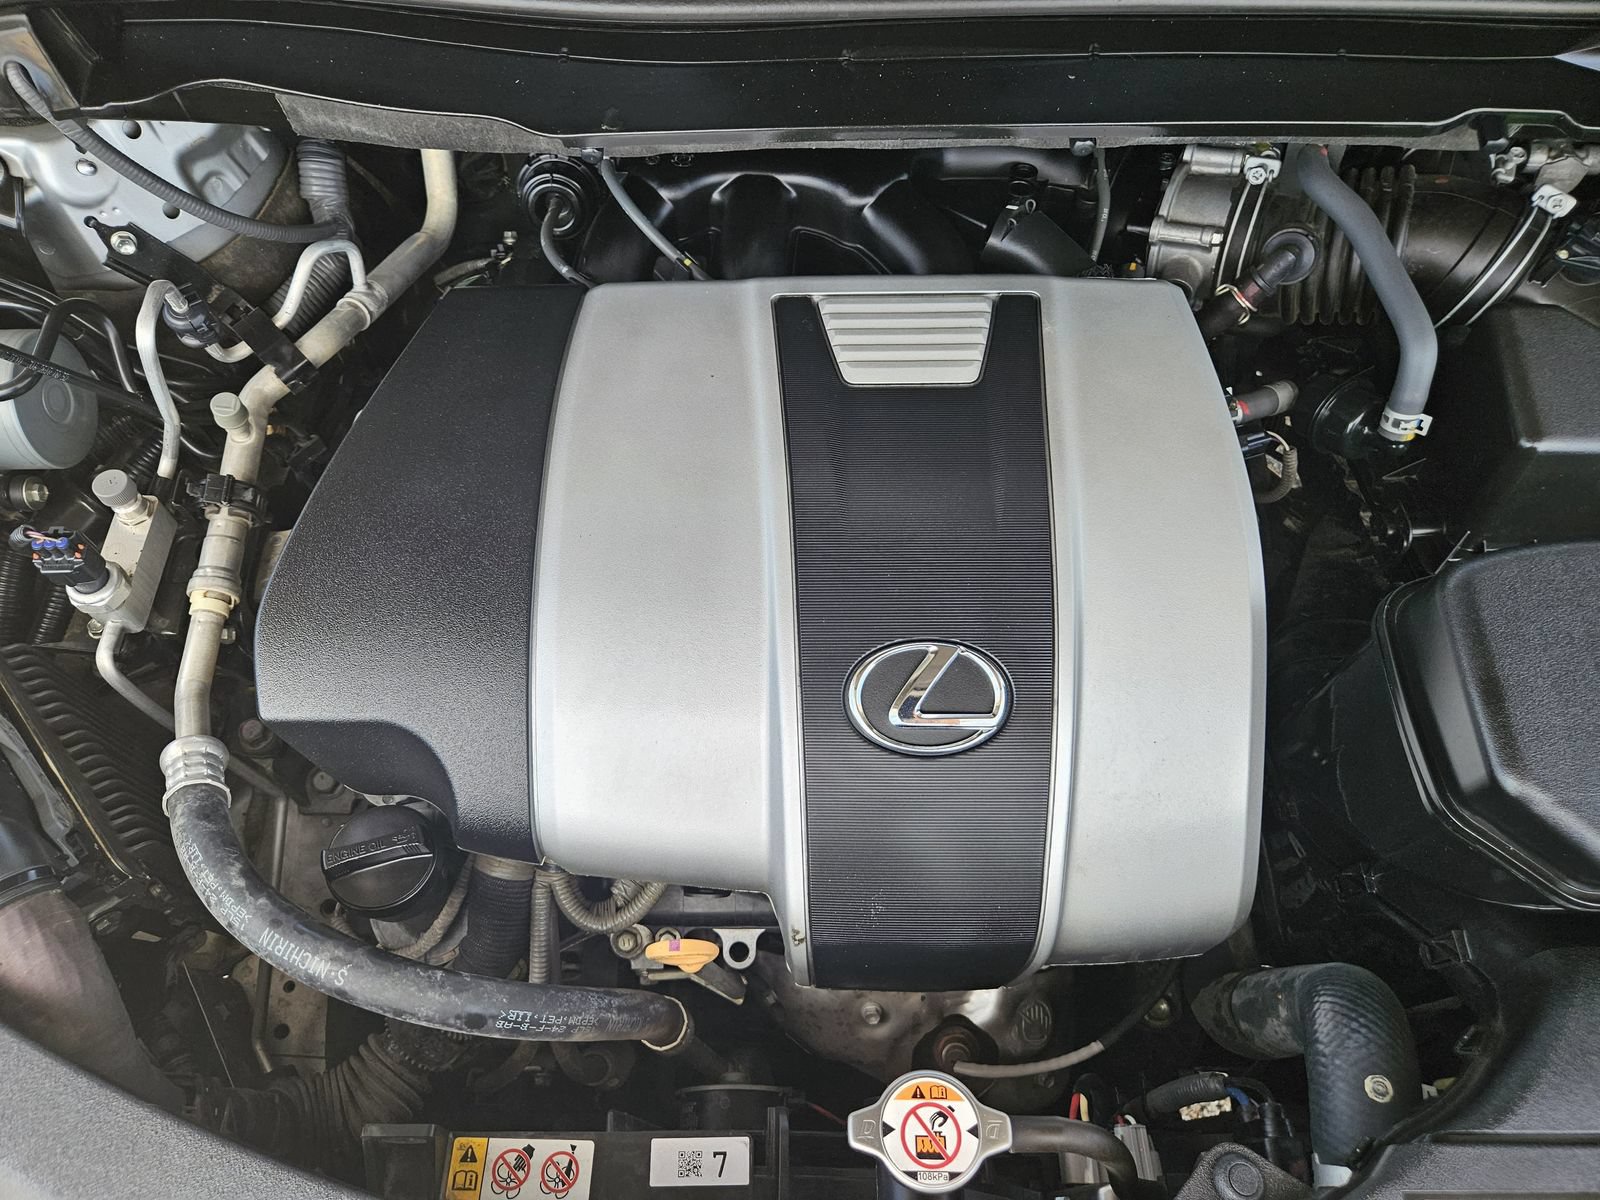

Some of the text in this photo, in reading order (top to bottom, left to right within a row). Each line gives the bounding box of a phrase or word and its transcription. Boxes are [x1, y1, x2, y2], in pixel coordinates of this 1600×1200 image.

[327, 840, 386, 864] ENGINE OIL
[712, 1151, 728, 1178] 7
[918, 1172, 948, 1181] 108kPa
